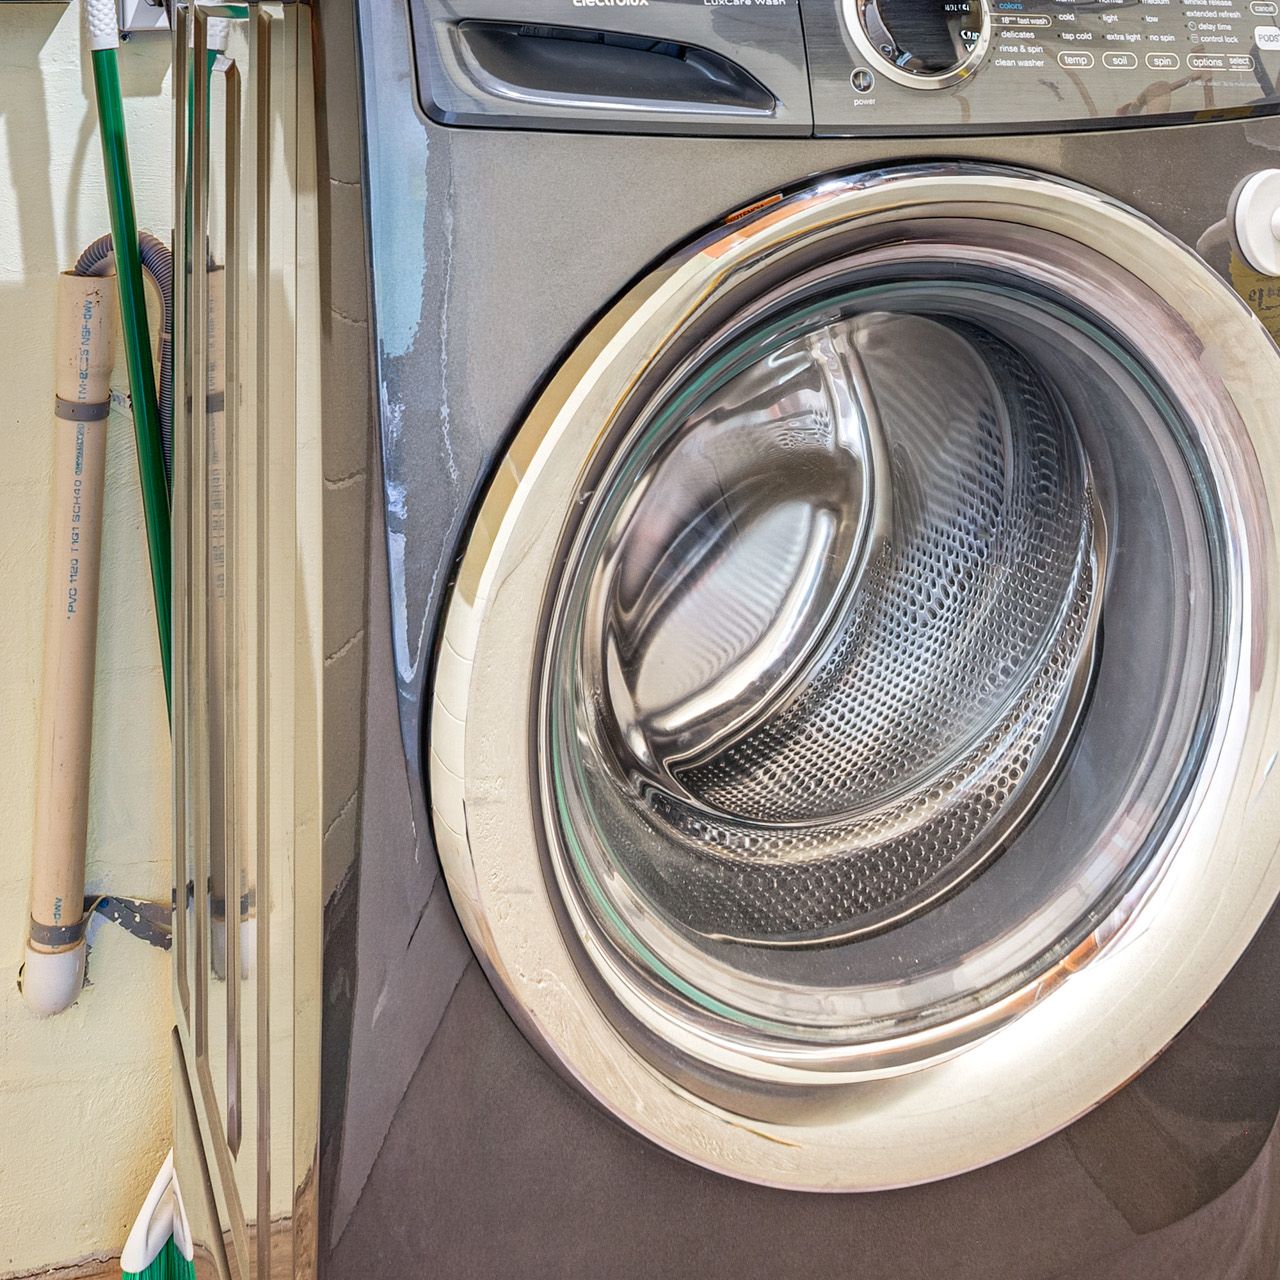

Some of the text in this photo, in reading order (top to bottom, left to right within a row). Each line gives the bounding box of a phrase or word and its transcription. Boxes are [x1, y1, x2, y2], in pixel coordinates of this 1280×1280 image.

[999, 2, 1023, 10] colors
[1058, 13, 1075, 21] cold
[1186, 10, 1217, 18] extended
[1102, 14, 1118, 23] light
[1198, 23, 1216, 31] delay
[1001, 31, 1035, 39] delicates
[1062, 32, 1092, 41] tap cold
[1126, 33, 1141, 42] light
[1160, 34, 1175, 42] spin
[1201, 35, 1239, 43] control lock
[999, 45, 1043, 54] rinse & spin
[995, 59, 1044, 67] clean washer
[1064, 56, 1087, 65] temp
[1112, 56, 1128, 64] soil
[1153, 57, 1171, 66] spin
[1193, 56, 1250, 67] options select
[854, 98, 876, 106] power
[71, 480, 83, 523] SCH40
[67, 587, 79, 613] PVC
